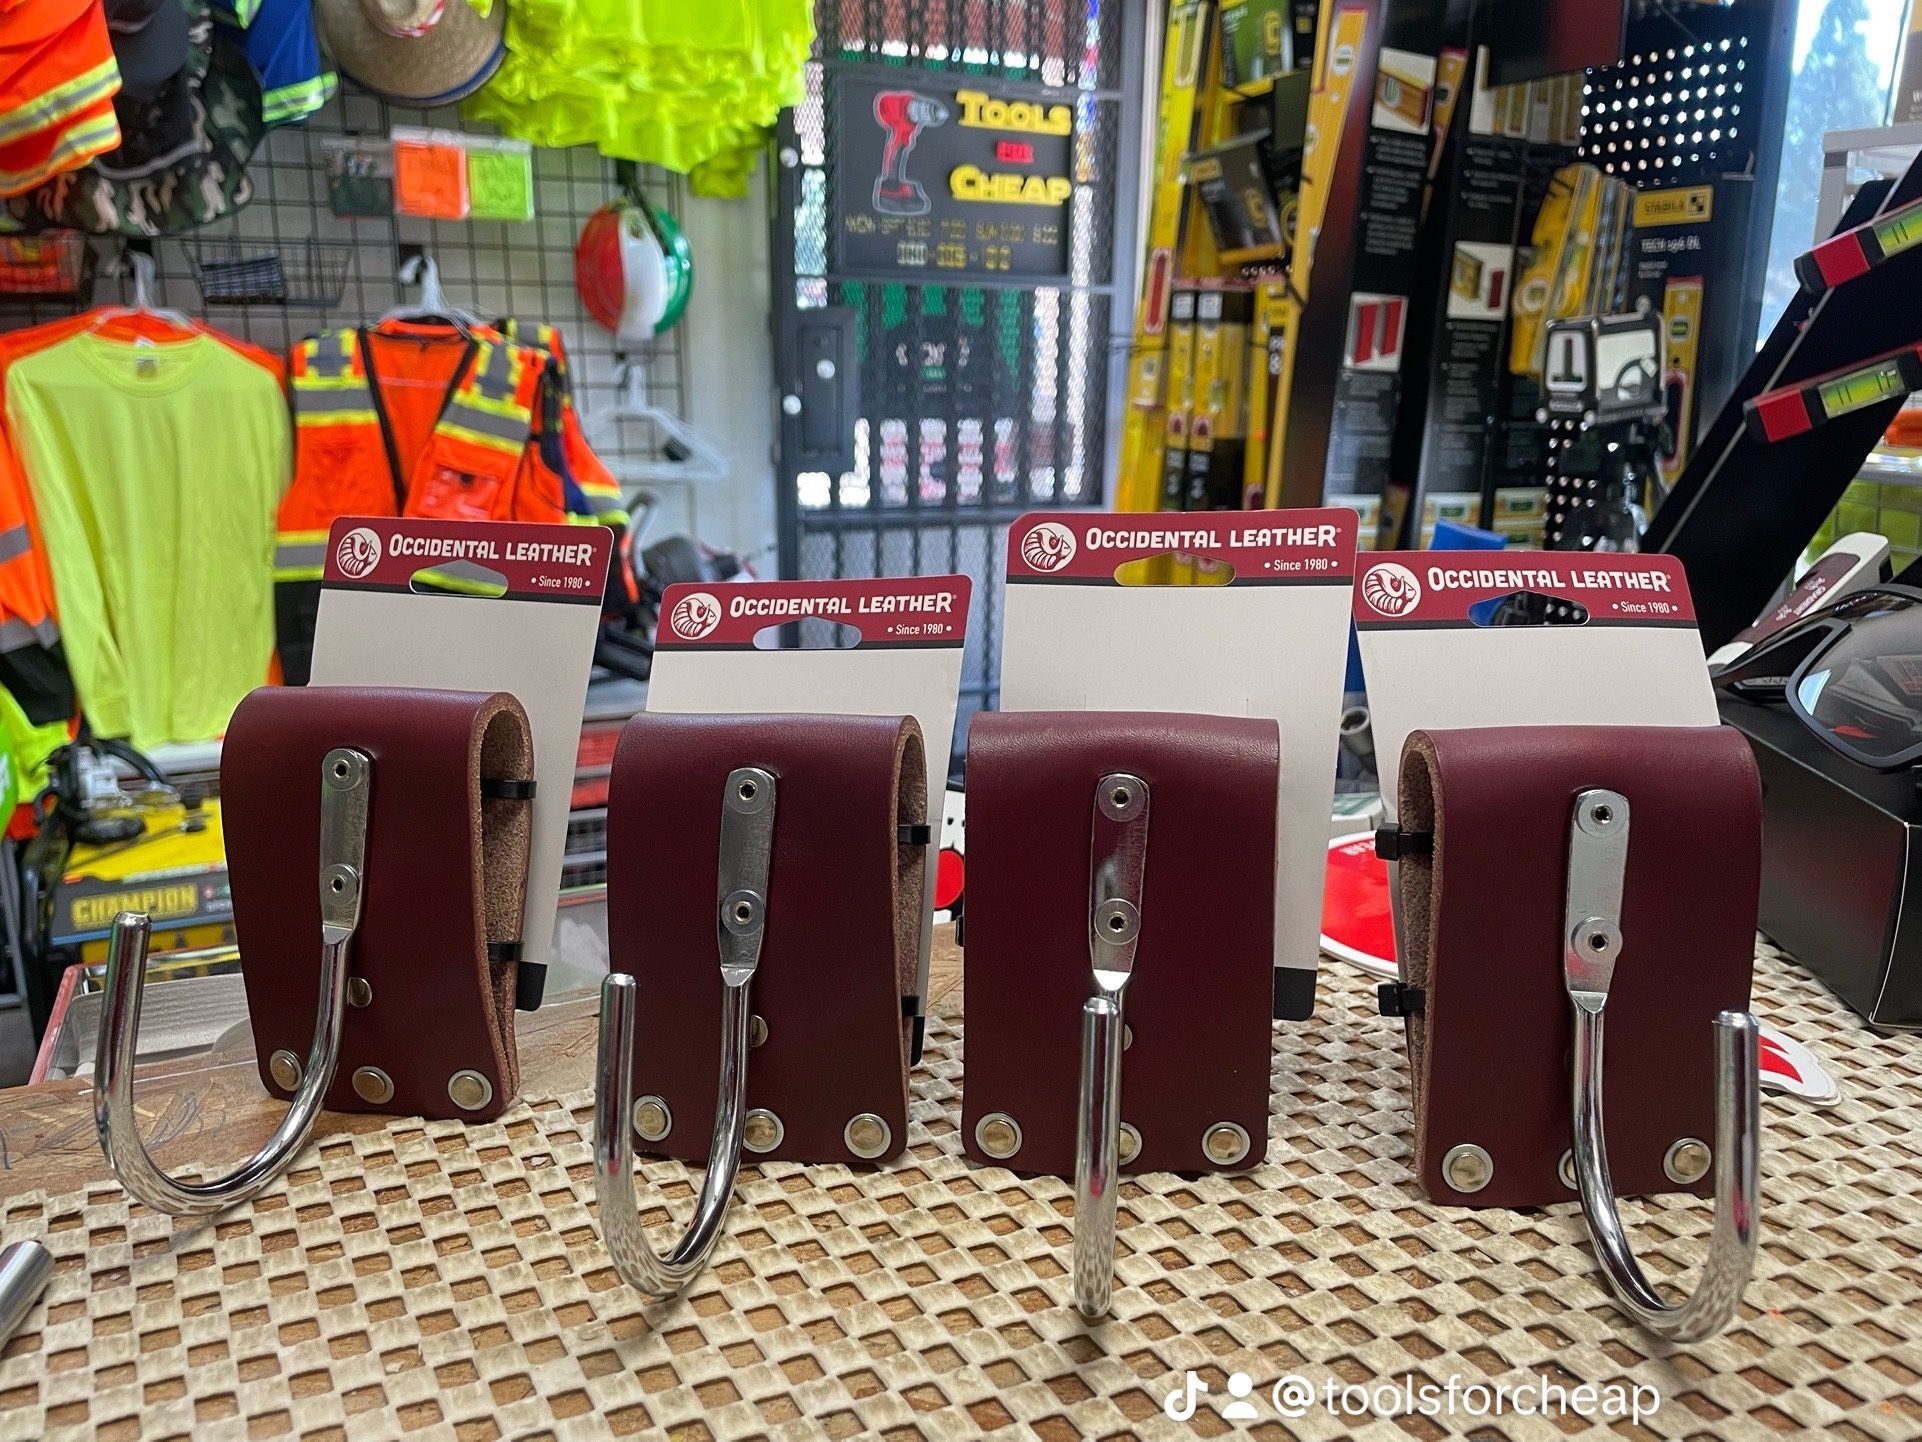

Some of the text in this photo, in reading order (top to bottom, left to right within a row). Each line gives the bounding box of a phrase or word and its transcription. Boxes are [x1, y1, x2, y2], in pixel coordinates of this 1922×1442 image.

[389, 533, 592, 566] OCCIDENTAL LEATHER
[1086, 525, 1337, 550] OCCIDENTAL LEATHER
[1273, 558, 1328, 571] Since 1980
[538, 575, 583, 589] Since 1980
[1427, 566, 1671, 593] OCCIDENTAL LEATHER
[729, 592, 953, 618] OCCIDENTAL LEATHER
[1620, 600, 1670, 614] Since 1980
[895, 623, 943, 635] Since 1980
[73, 883, 197, 928] CHAMPION
